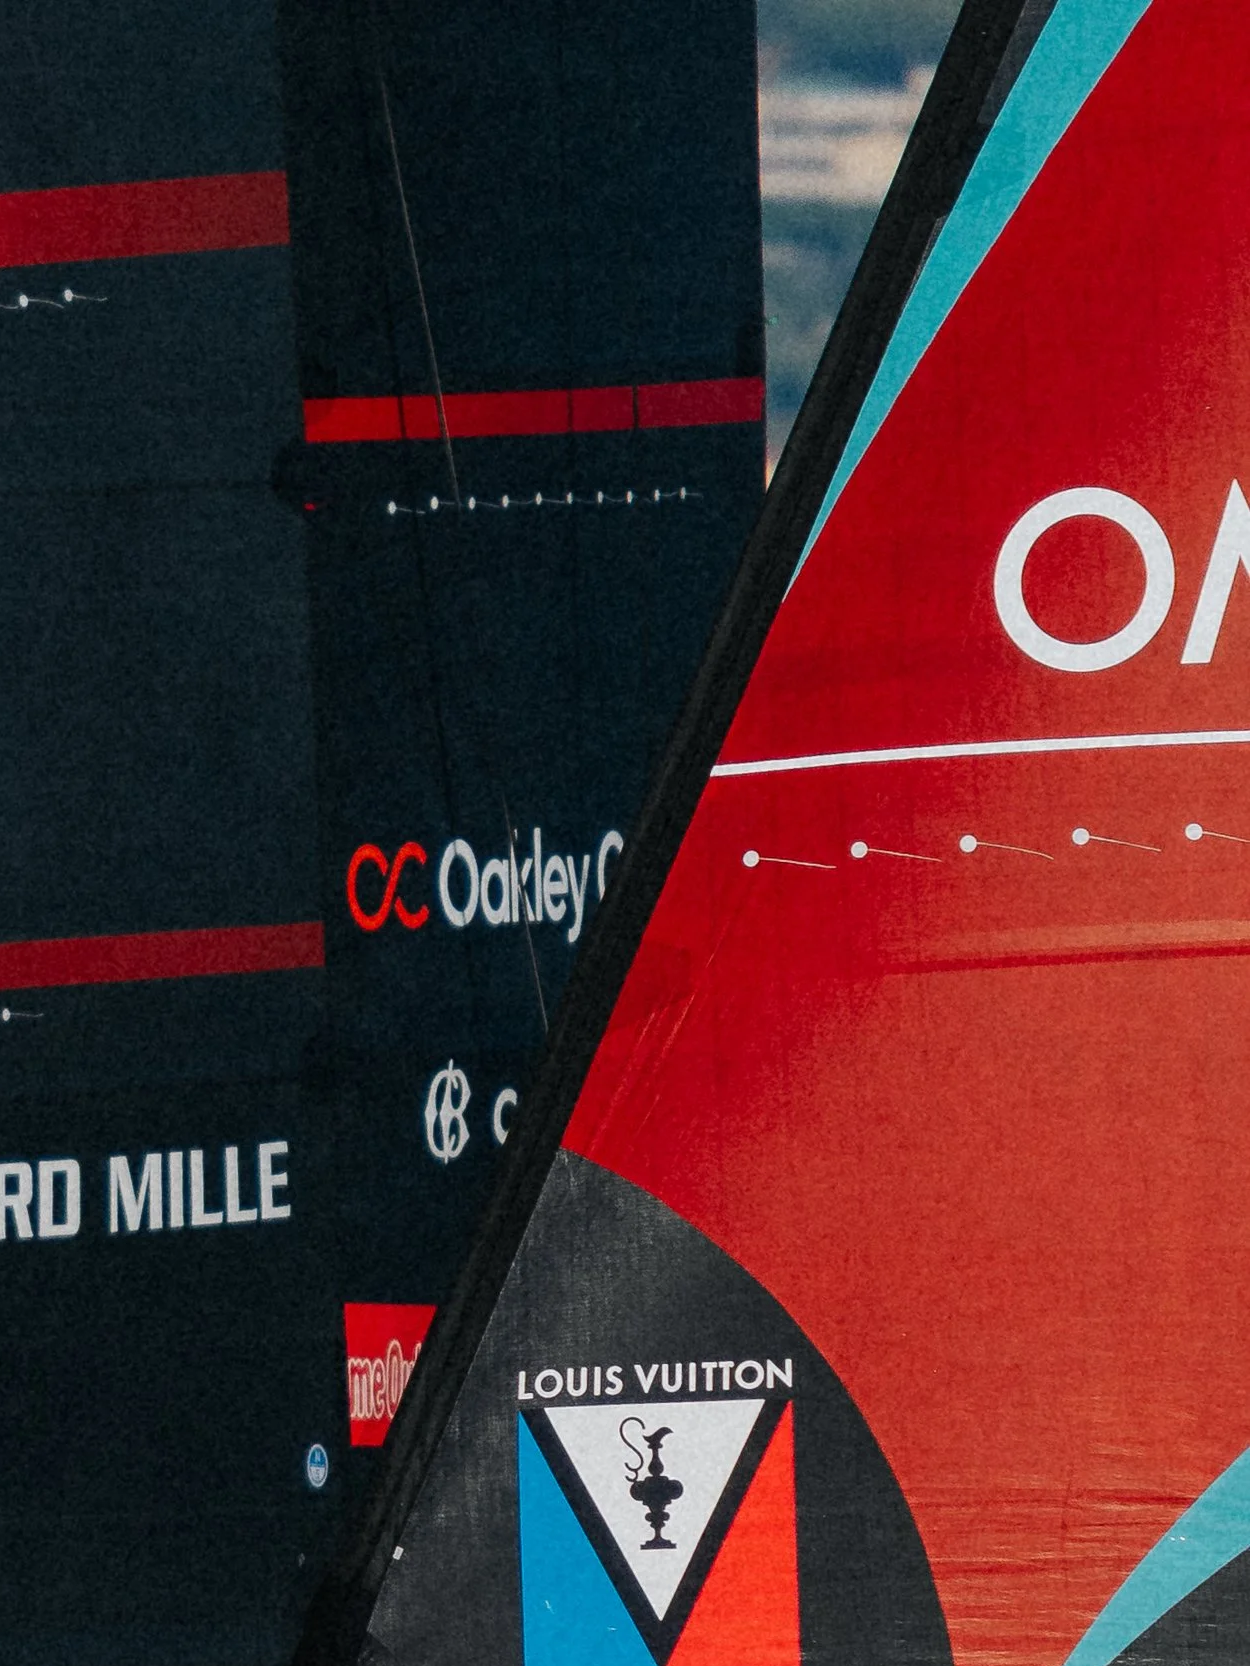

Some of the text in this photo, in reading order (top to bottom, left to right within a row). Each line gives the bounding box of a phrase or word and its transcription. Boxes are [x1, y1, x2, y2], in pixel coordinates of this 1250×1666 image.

[438, 827, 591, 943] Oakley
[108, 1140, 291, 1235] MILLE
[517, 1358, 793, 1400] LOUIS VUITTON
